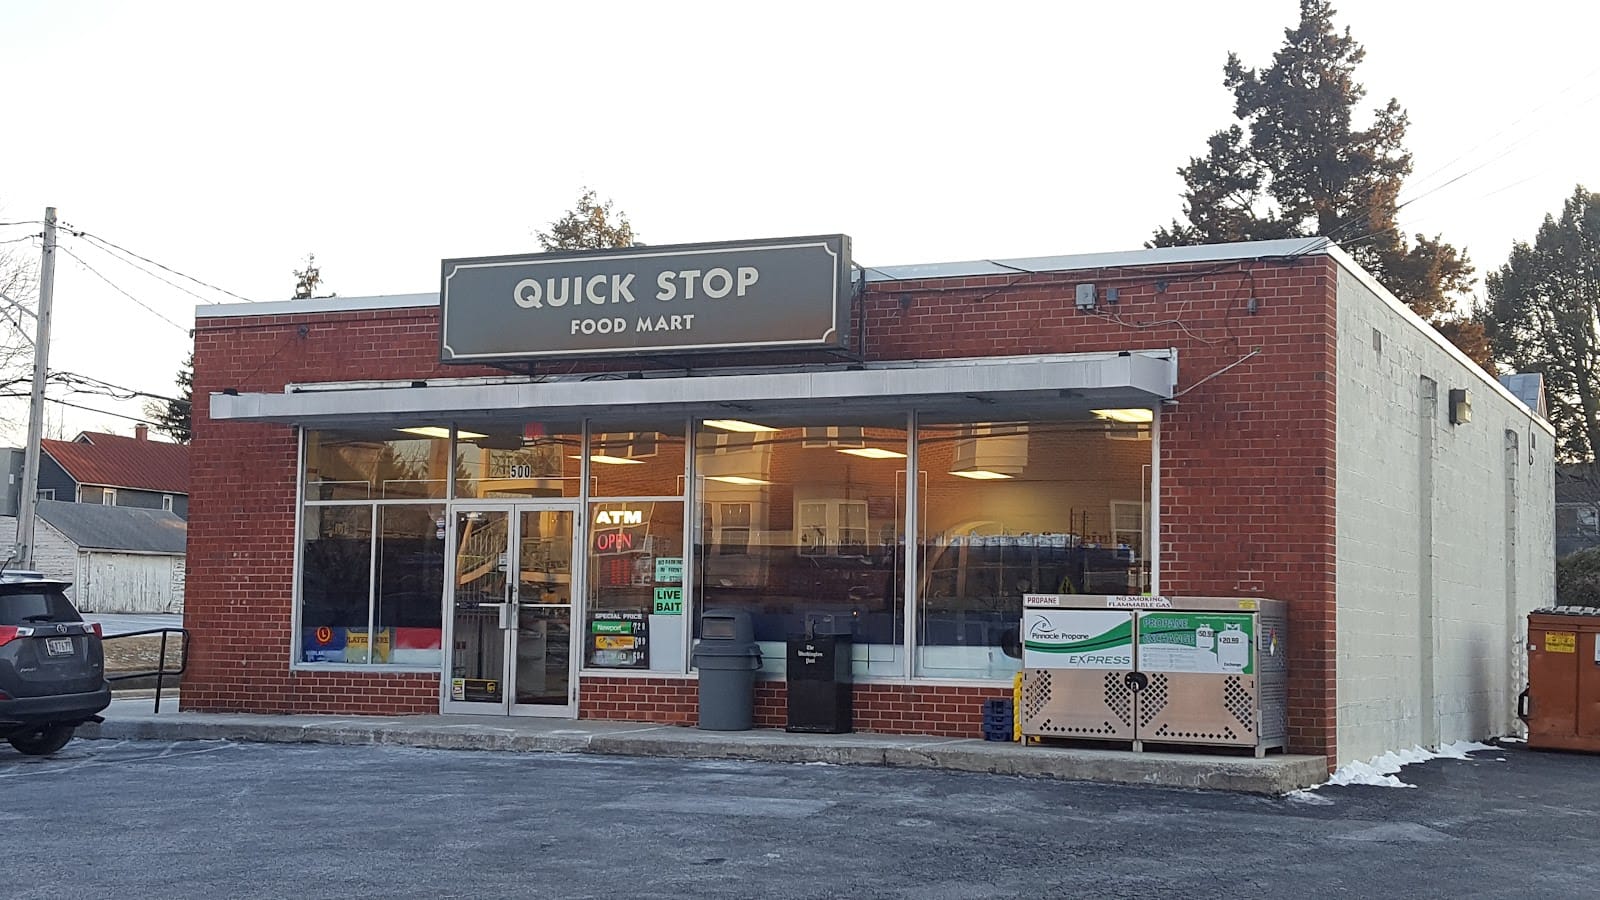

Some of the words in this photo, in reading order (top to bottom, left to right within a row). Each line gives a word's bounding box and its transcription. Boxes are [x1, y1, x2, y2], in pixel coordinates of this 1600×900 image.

[513, 274, 635, 309] QUICK
[656, 267, 759, 301] STOP
[570, 317, 628, 335] FOOD
[635, 314, 695, 333] MART
[511, 465, 530, 478] 500
[596, 511, 641, 524] ATM
[597, 534, 632, 549] OPEN
[657, 591, 681, 599] LIVE
[1027, 597, 1057, 605] PROPANE
[656, 603, 681, 611] BAIT
[597, 623, 622, 631] Newport
[1143, 617, 1188, 629] PROPANE
[1069, 654, 1130, 665] EXPRESS
